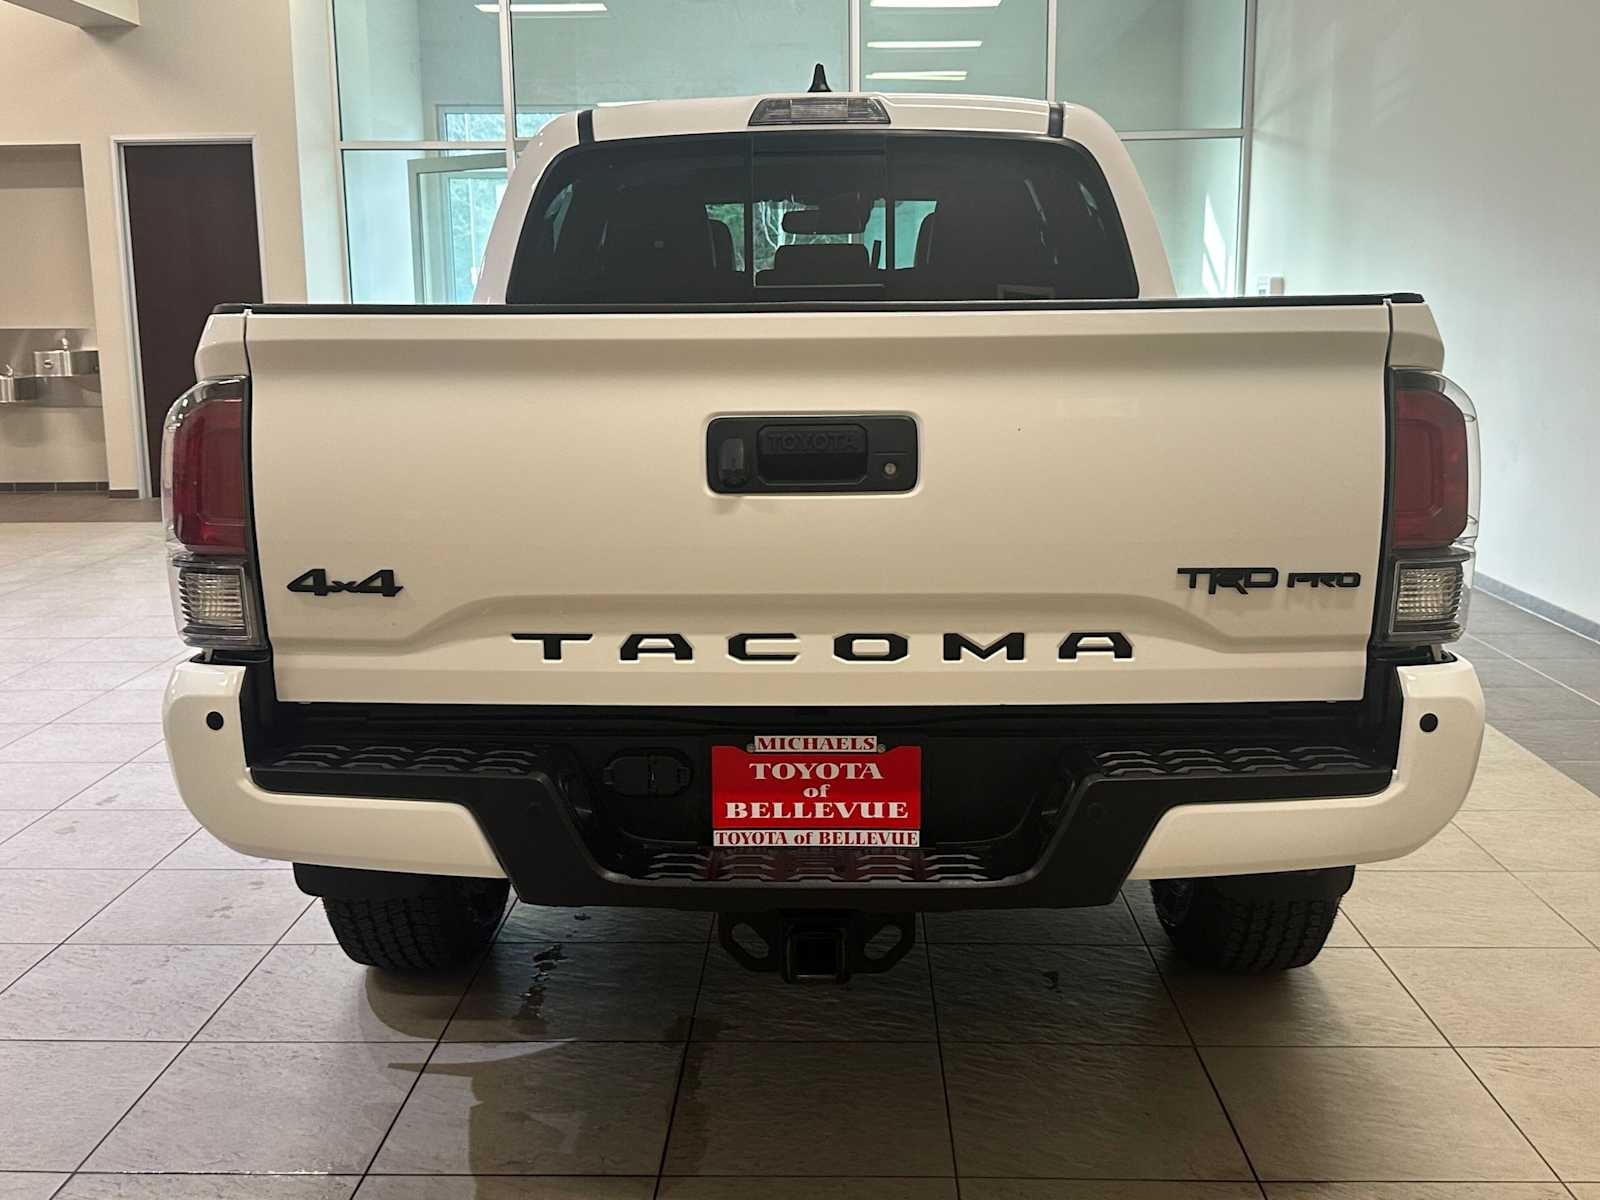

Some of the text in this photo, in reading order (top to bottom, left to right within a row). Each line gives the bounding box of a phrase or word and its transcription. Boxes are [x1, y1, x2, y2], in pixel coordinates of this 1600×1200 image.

[767, 432, 859, 450] TOYOTA
[286, 568, 404, 597] 4x4
[1177, 567, 1362, 595] TRD PRO
[511, 632, 1133, 662] TACOMA
[757, 737, 875, 751] MICHAELS
[749, 762, 884, 780] TOYOTA
[803, 784, 831, 798] of
[725, 802, 908, 819] BELLEVUE
[715, 831, 918, 846] TOYOTA of BELLEVUE
